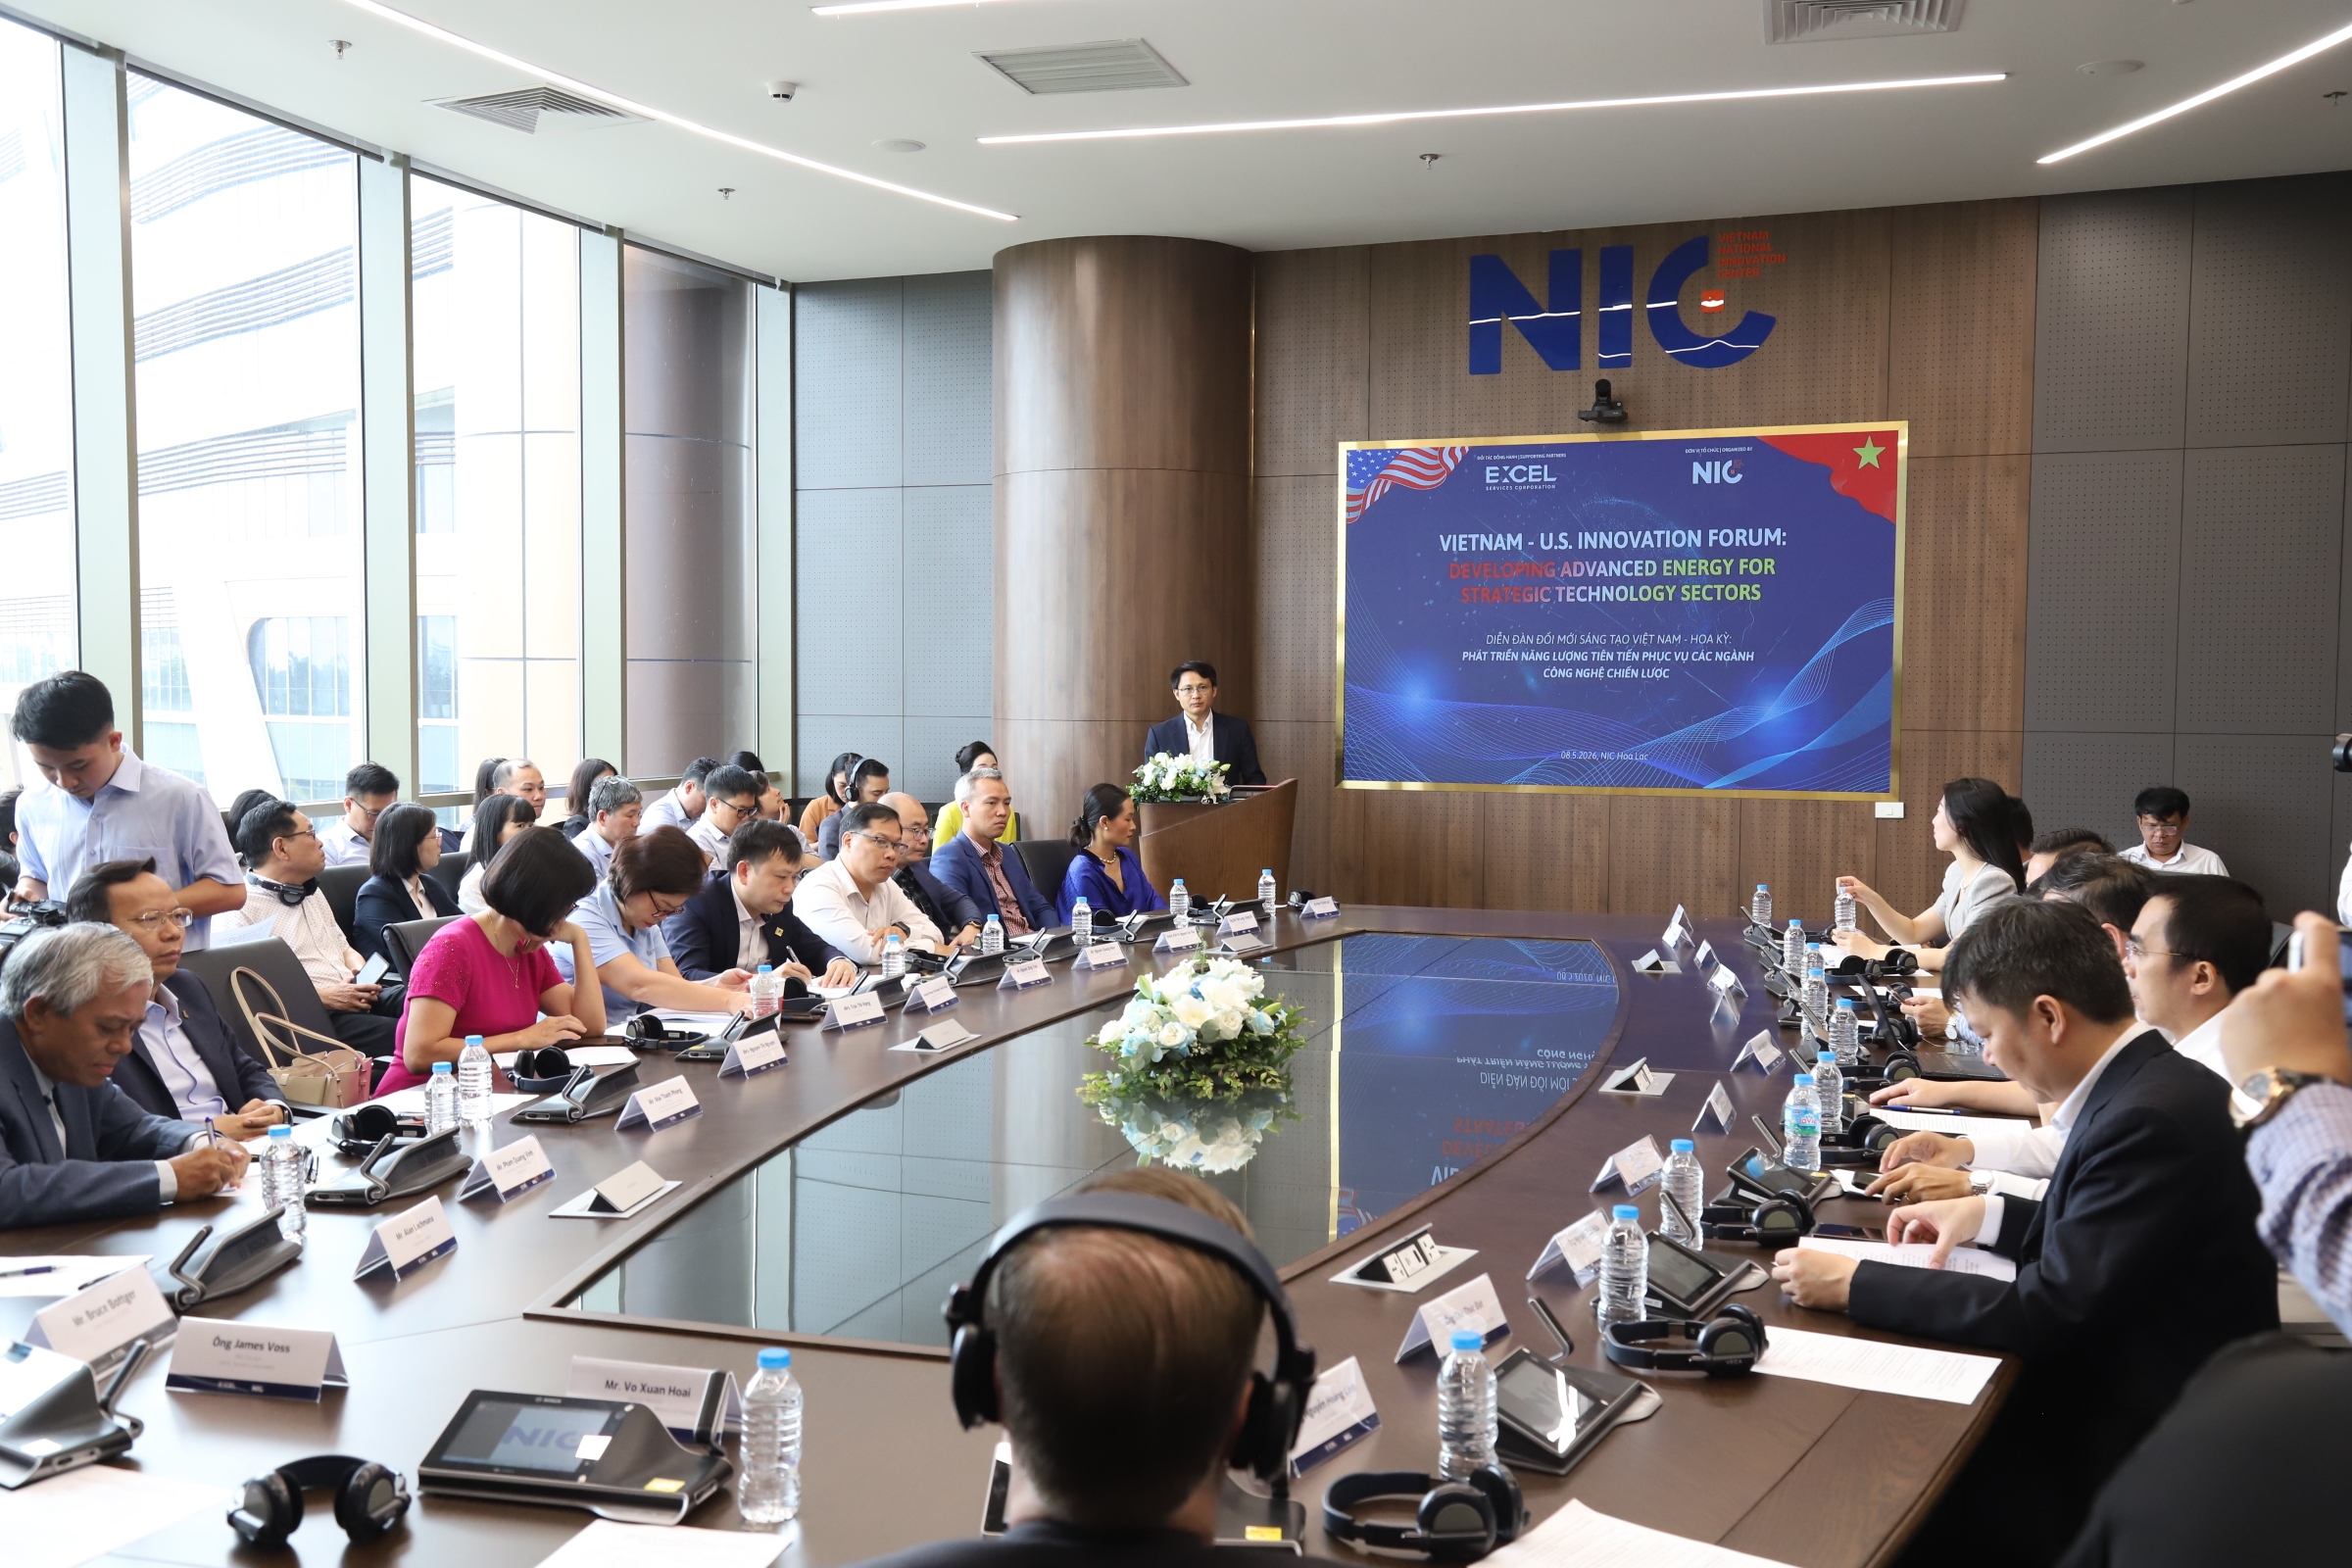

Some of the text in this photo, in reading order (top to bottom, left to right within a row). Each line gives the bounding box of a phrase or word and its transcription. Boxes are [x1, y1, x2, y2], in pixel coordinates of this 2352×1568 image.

[1719, 230, 1769, 242] VIETNAM
[1718, 243, 1773, 255] NATIONAL
[1718, 254, 1787, 267] INNOVATION
[1718, 268, 1761, 279] CENTER
[1469, 235, 1777, 374] NIC
[1486, 465, 1557, 483] EXCEL
[1692, 460, 1742, 484] NIC
[1440, 532, 1523, 552] VIETNAM
[1541, 532, 1572, 551] U.S.
[1578, 529, 1701, 550] INNOVATION
[1708, 527, 1787, 547] FORUM:
[1449, 559, 1776, 579] DEVELOPING ADVANCED ENERGY FOR
[1460, 584, 1762, 604] STRATEGIC TECHNOLOGY SECTORS
[1486, 631, 1509, 645] DIỄN
[1512, 632, 1534, 645] ĐÀN
[1537, 631, 1554, 645] ĐỔI
[1557, 632, 1577, 645] MỚI
[1580, 632, 1606, 644] SÁNG
[1609, 634, 1630, 646] TẠO
[1633, 632, 1655, 646] VIỆT
[1657, 634, 1682, 644] NAM
[1690, 634, 1714, 644] HOA
[1716, 632, 1732, 644] KỲ:
[1462, 649, 1754, 663] PHÁT TRIỂN NĂNG LƯỢNG TIÊN TIẾN PHỤC VỤ CÁC NGÀNH
[1544, 665, 1670, 680] CÔNG NGHỆ CHIẾN LƯỢC
[84, 1304, 109, 1321] Bruce
[213, 1336, 290, 1353] Ông James Voss
[605, 1380, 691, 1397] Mr. Vo Xuan Hoai
